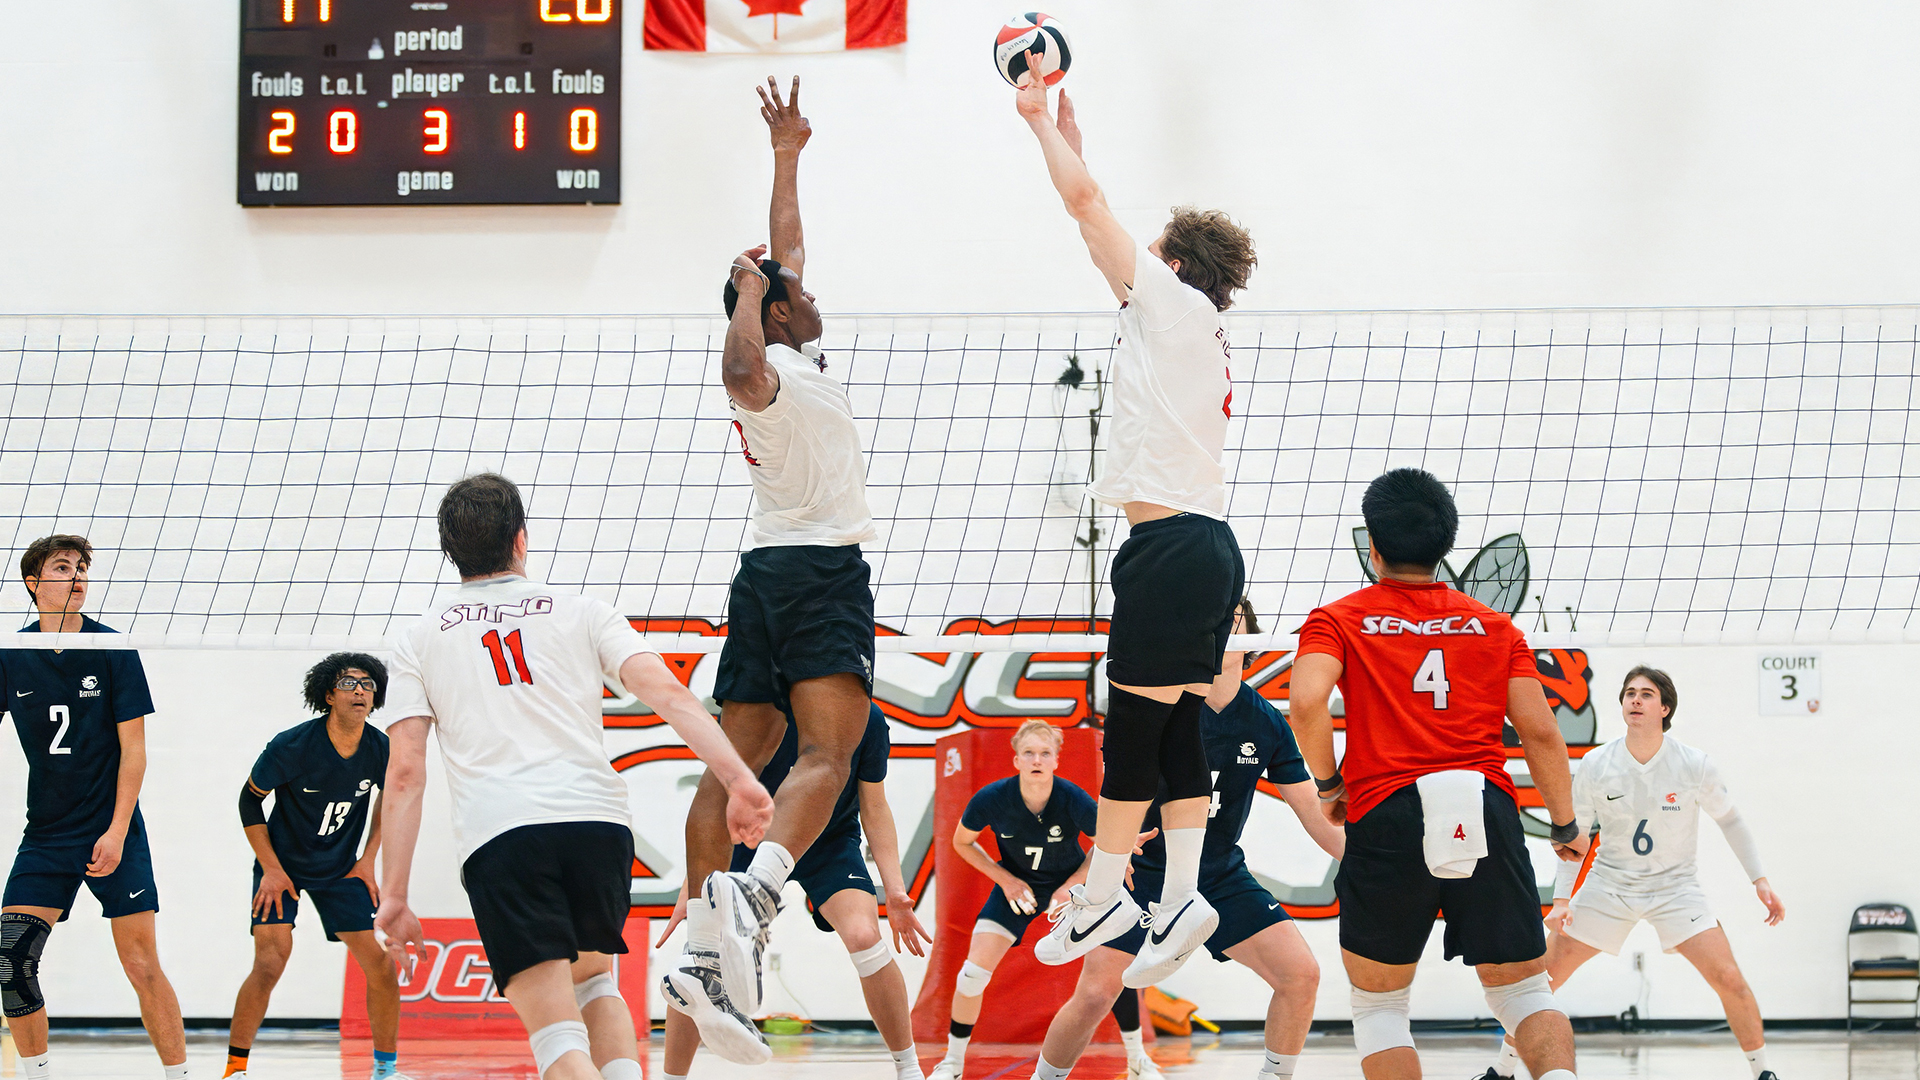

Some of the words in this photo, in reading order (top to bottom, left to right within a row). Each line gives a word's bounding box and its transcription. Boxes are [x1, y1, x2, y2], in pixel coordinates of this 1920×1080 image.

[394, 25, 463, 56] period
[252, 71, 304, 97] fouls
[391, 67, 465, 98] player
[552, 68, 605, 95] fouls
[268, 111, 296, 154] 2
[329, 110, 357, 153] 0
[423, 110, 448, 153] 3
[514, 111, 525, 149] 1
[569, 108, 597, 152] 0
[255, 172, 299, 192] won
[397, 171, 454, 196] game
[556, 169, 600, 190] won
[440, 595, 553, 632] STING
[1360, 615, 1488, 636] SENECA
[481, 628, 534, 686] 11
[1761, 656, 1817, 671] COURT
[1412, 648, 1451, 711] 4
[1781, 674, 1799, 701] 3
[48, 704, 72, 755] 2
[317, 801, 352, 836] 13
[1453, 823, 1467, 841] 4
[1632, 818, 1654, 857] 6
[1024, 846, 1044, 871] 7
